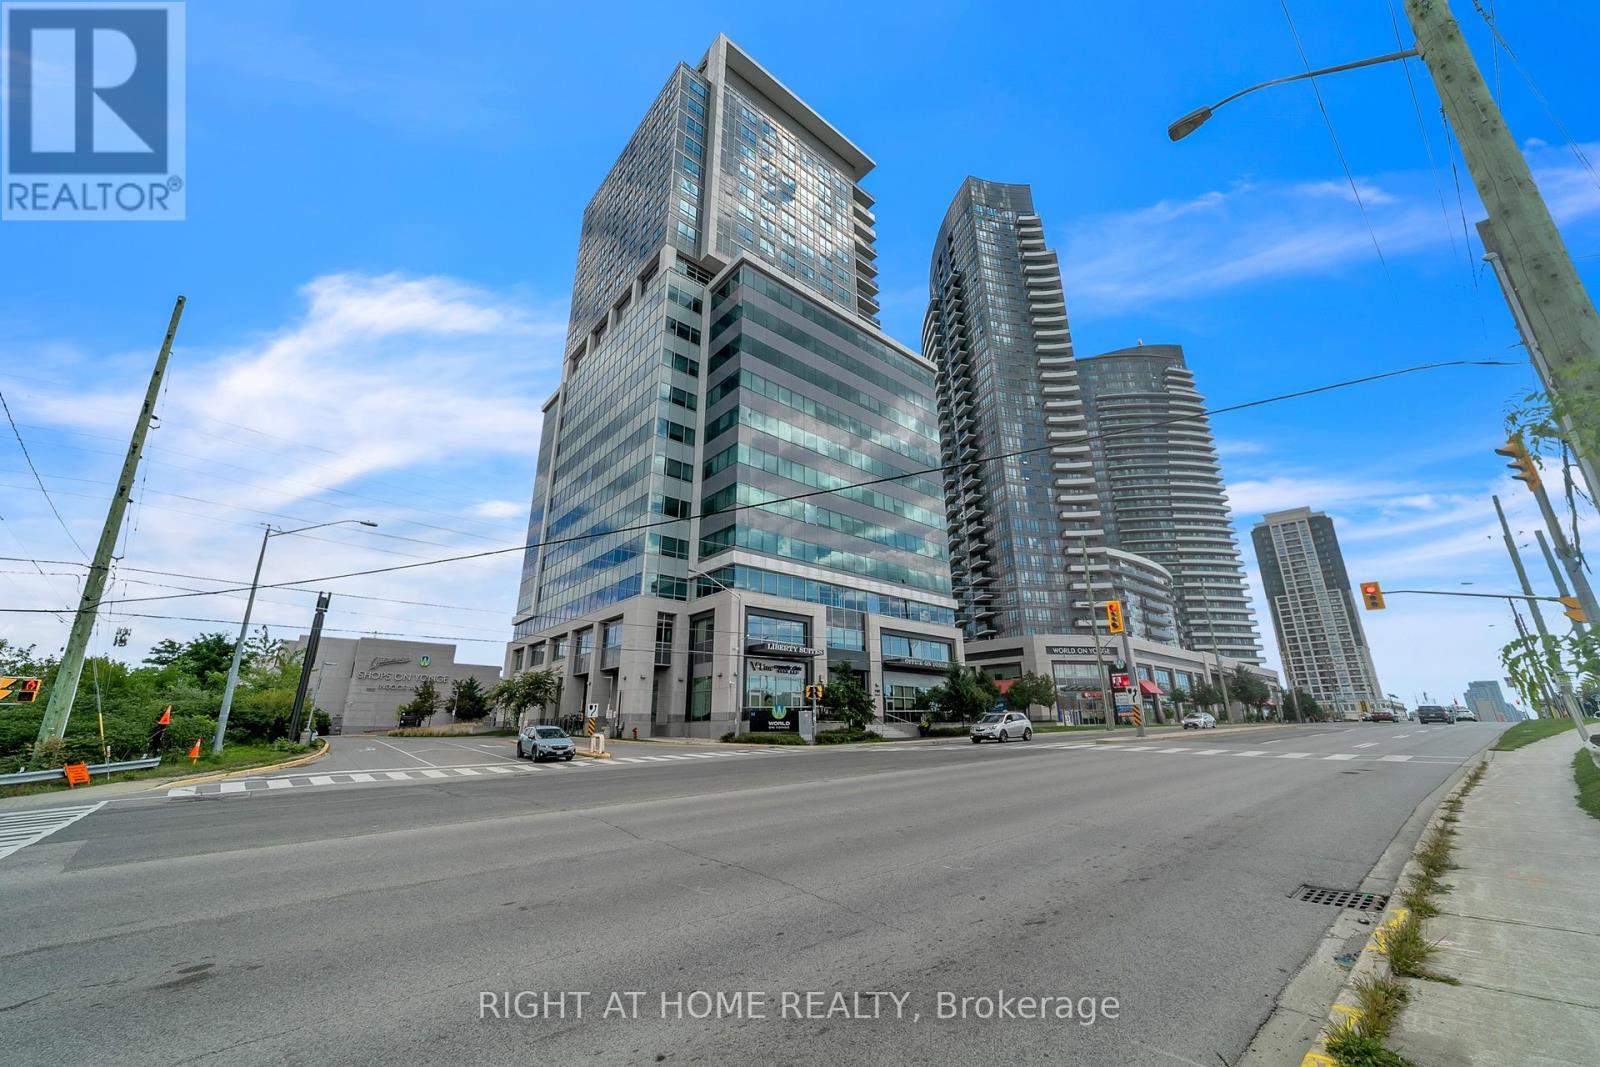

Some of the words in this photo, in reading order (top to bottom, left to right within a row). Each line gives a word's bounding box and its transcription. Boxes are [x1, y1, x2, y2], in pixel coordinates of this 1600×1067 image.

[767, 643, 798, 653] LIBERTY
[799, 647, 824, 655] SUITES
[358, 671, 391, 681] SHOPS
[394, 672, 412, 681] ON
